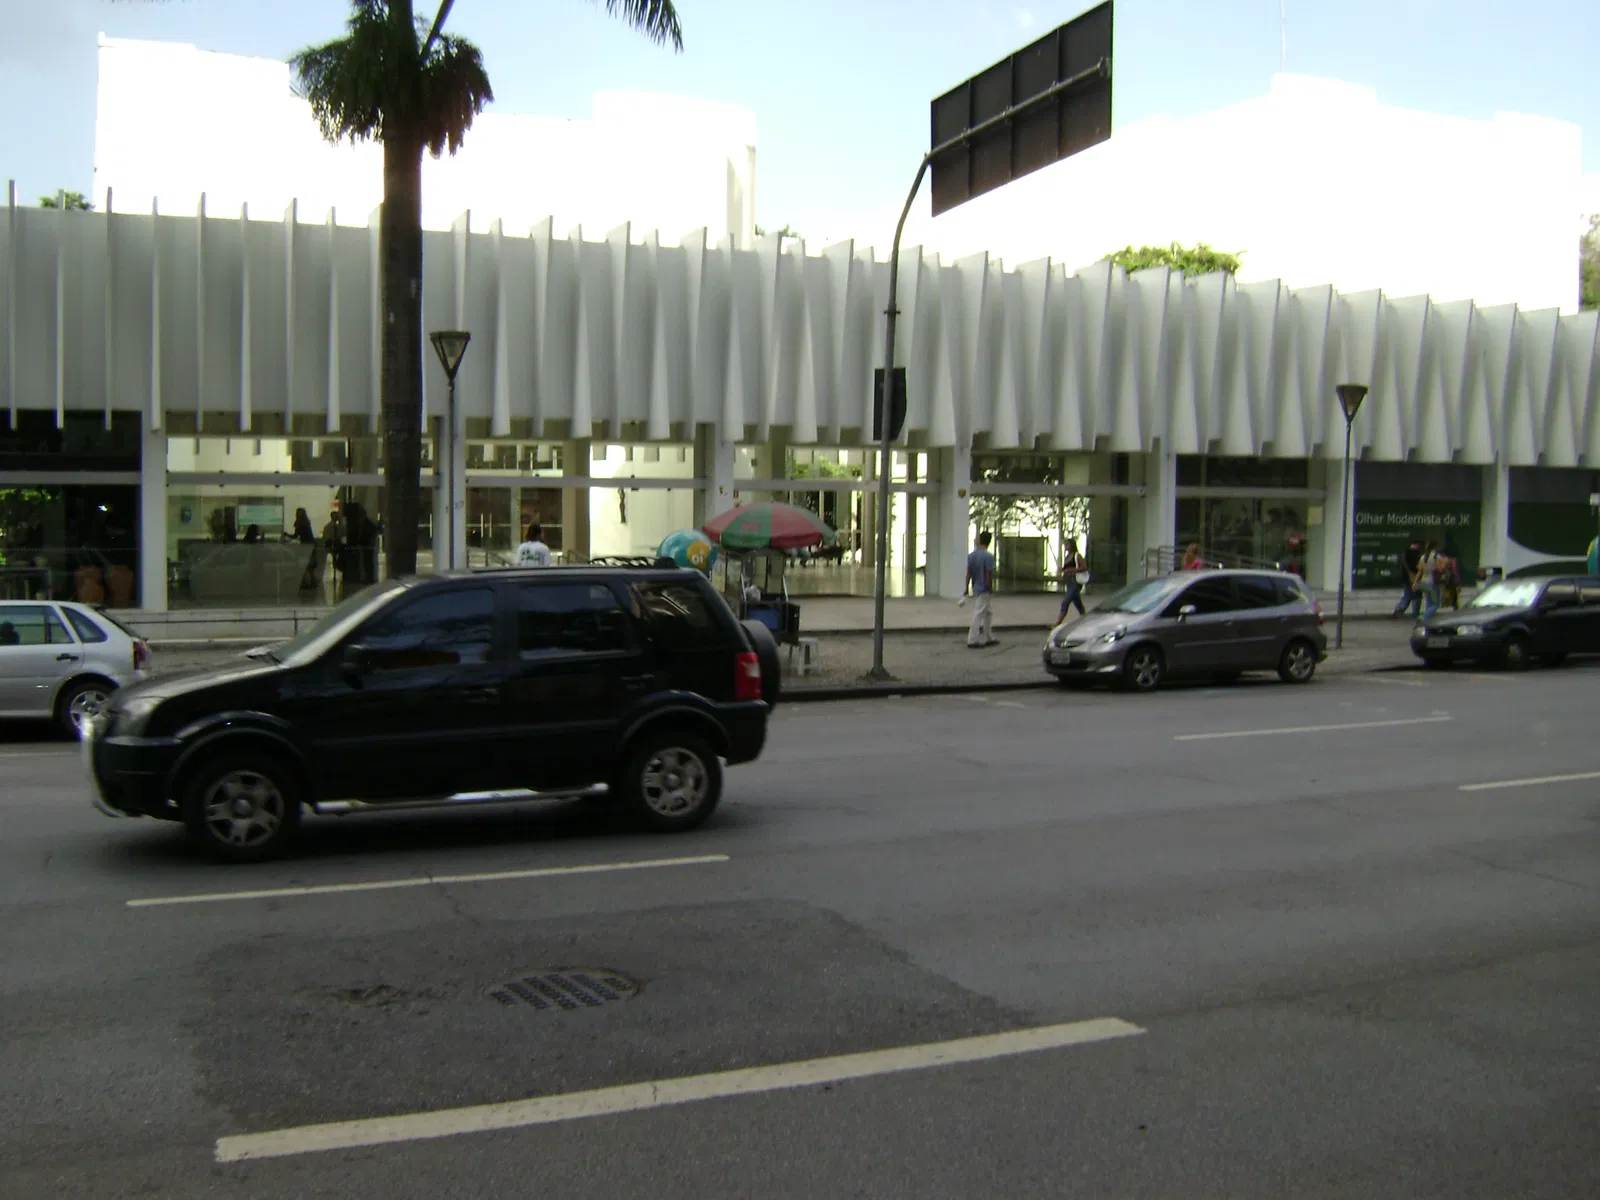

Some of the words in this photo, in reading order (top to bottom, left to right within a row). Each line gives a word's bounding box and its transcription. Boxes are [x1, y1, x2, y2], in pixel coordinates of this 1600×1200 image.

[1356, 512, 1384, 525] Olhar
[1387, 512, 1441, 525] Modernista
[1443, 512, 1457, 525] de
[1459, 512, 1471, 527] JK
